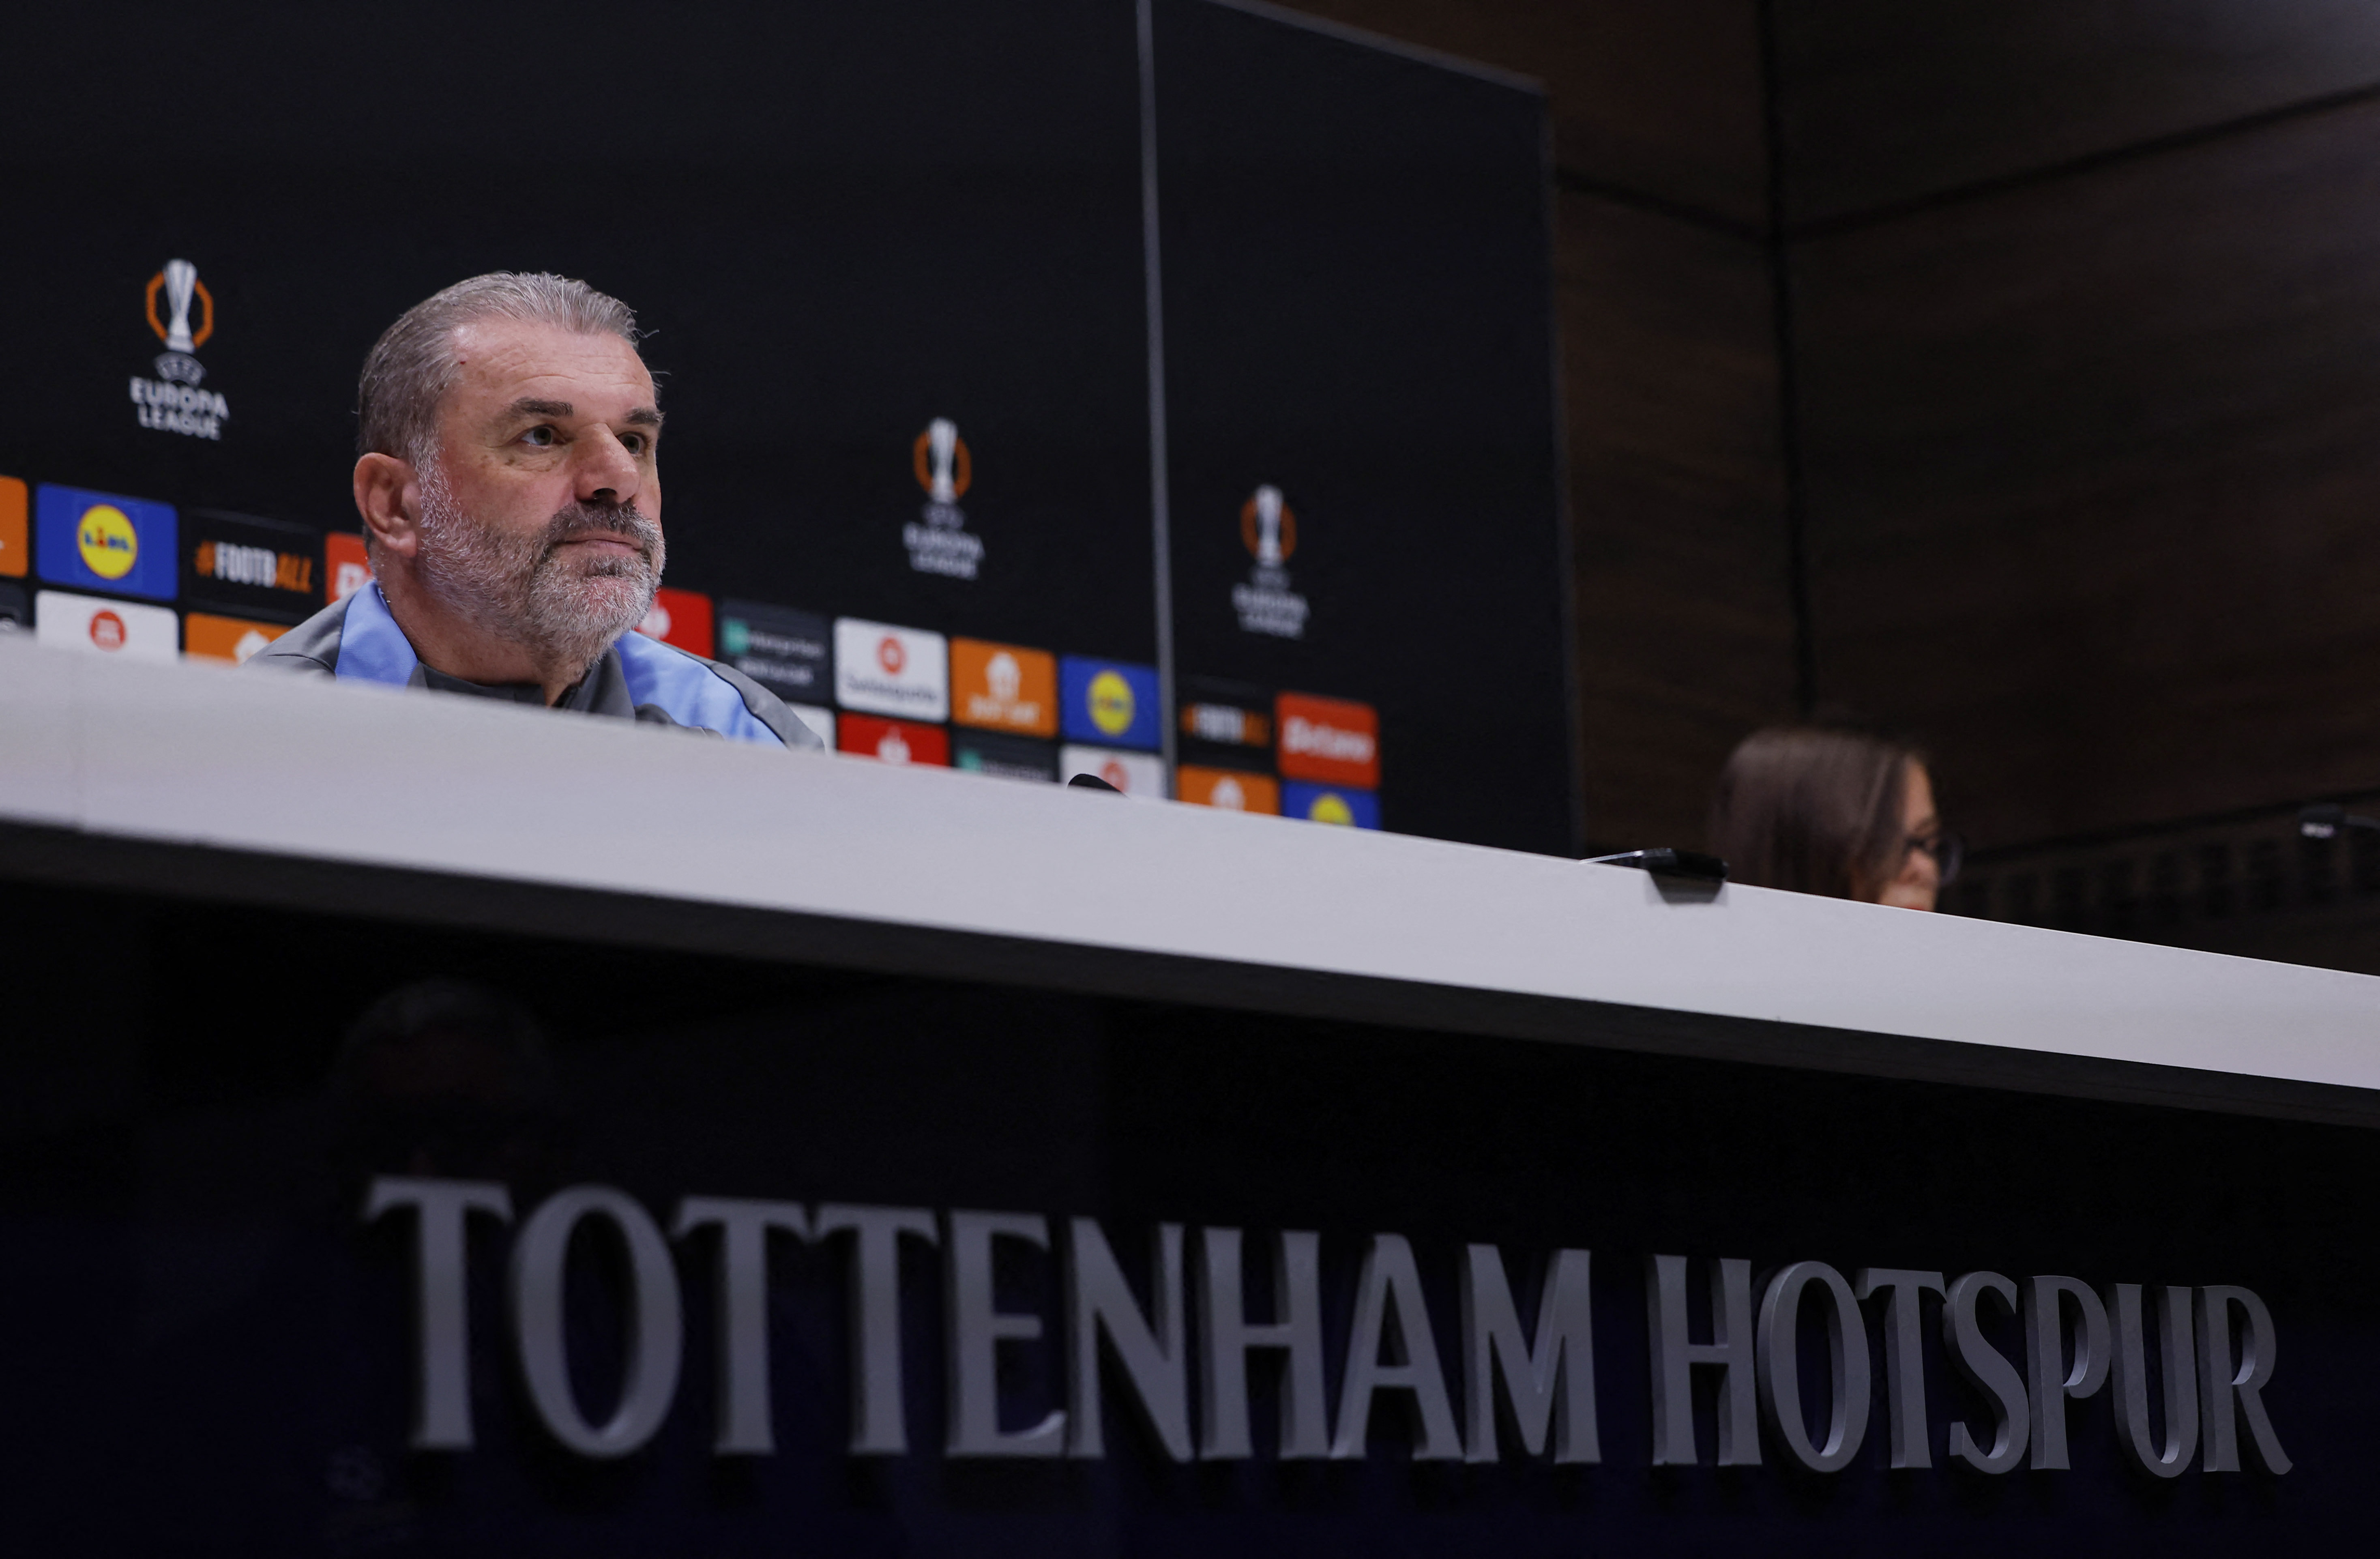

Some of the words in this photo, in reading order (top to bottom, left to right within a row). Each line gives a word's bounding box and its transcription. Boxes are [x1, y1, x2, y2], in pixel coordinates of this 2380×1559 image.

[129, 376, 230, 421] EUROPA
[138, 405, 221, 441] LEAGUE
[195, 540, 313, 593] #FOOTBALL
[367, 1175, 1602, 1465] TOTTENHAM
[1650, 1255, 2294, 1478] HOTSPUR
